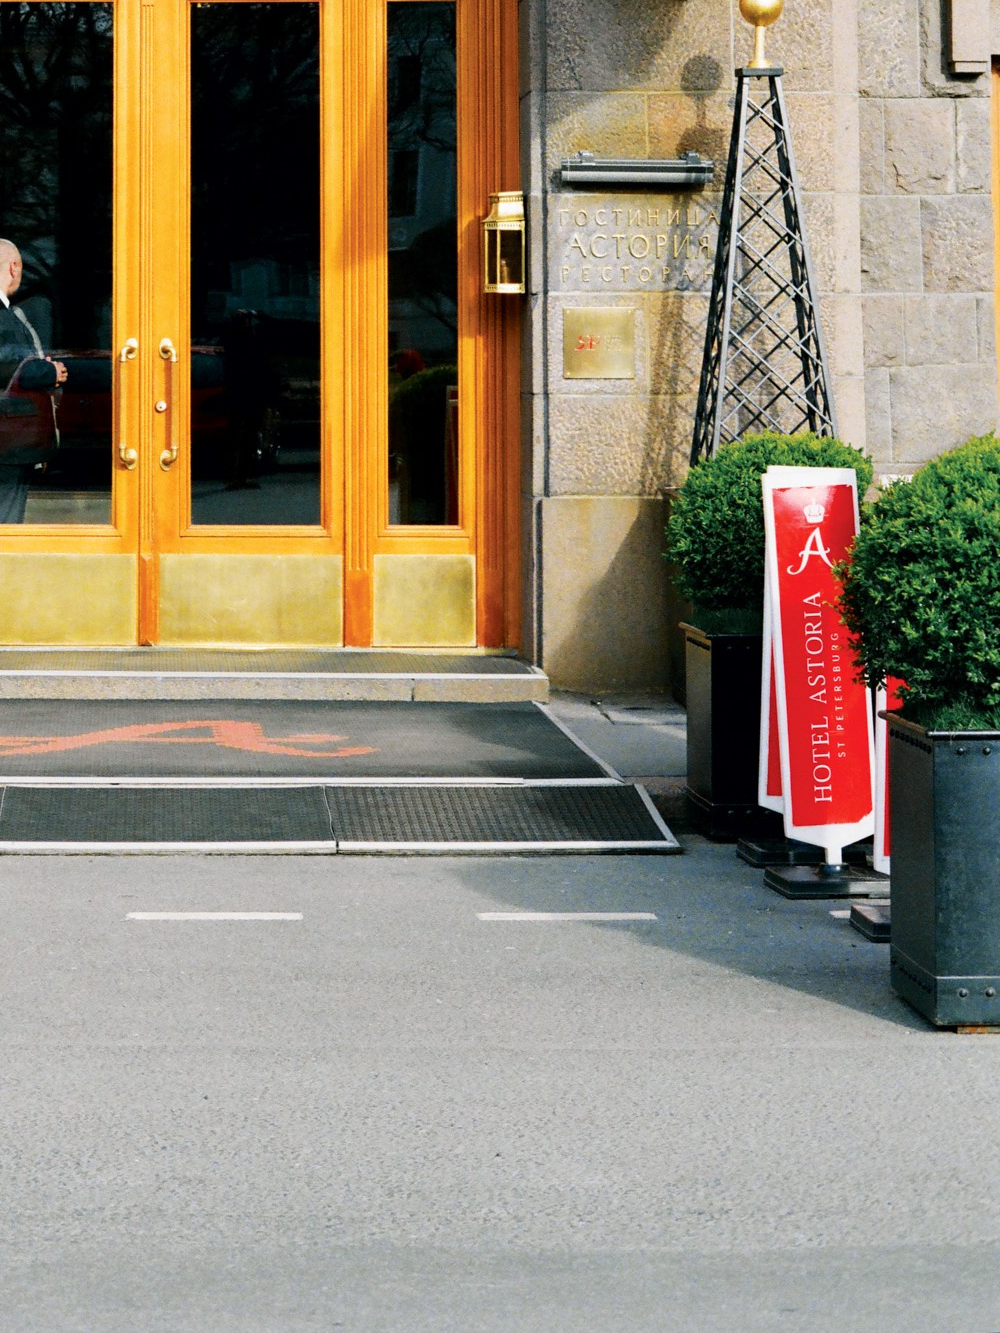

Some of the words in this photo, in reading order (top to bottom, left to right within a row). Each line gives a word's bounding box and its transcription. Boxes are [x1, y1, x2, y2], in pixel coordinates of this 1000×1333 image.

[559, 209, 720, 226] ГОСТИНИЦА
[565, 233, 711, 259] АСТОРИЯ
[803, 591, 828, 704] ASTORIA
[831, 632, 844, 731] PETERSBURG
[811, 716, 833, 803] HOTEL
[837, 742, 846, 758] ST
